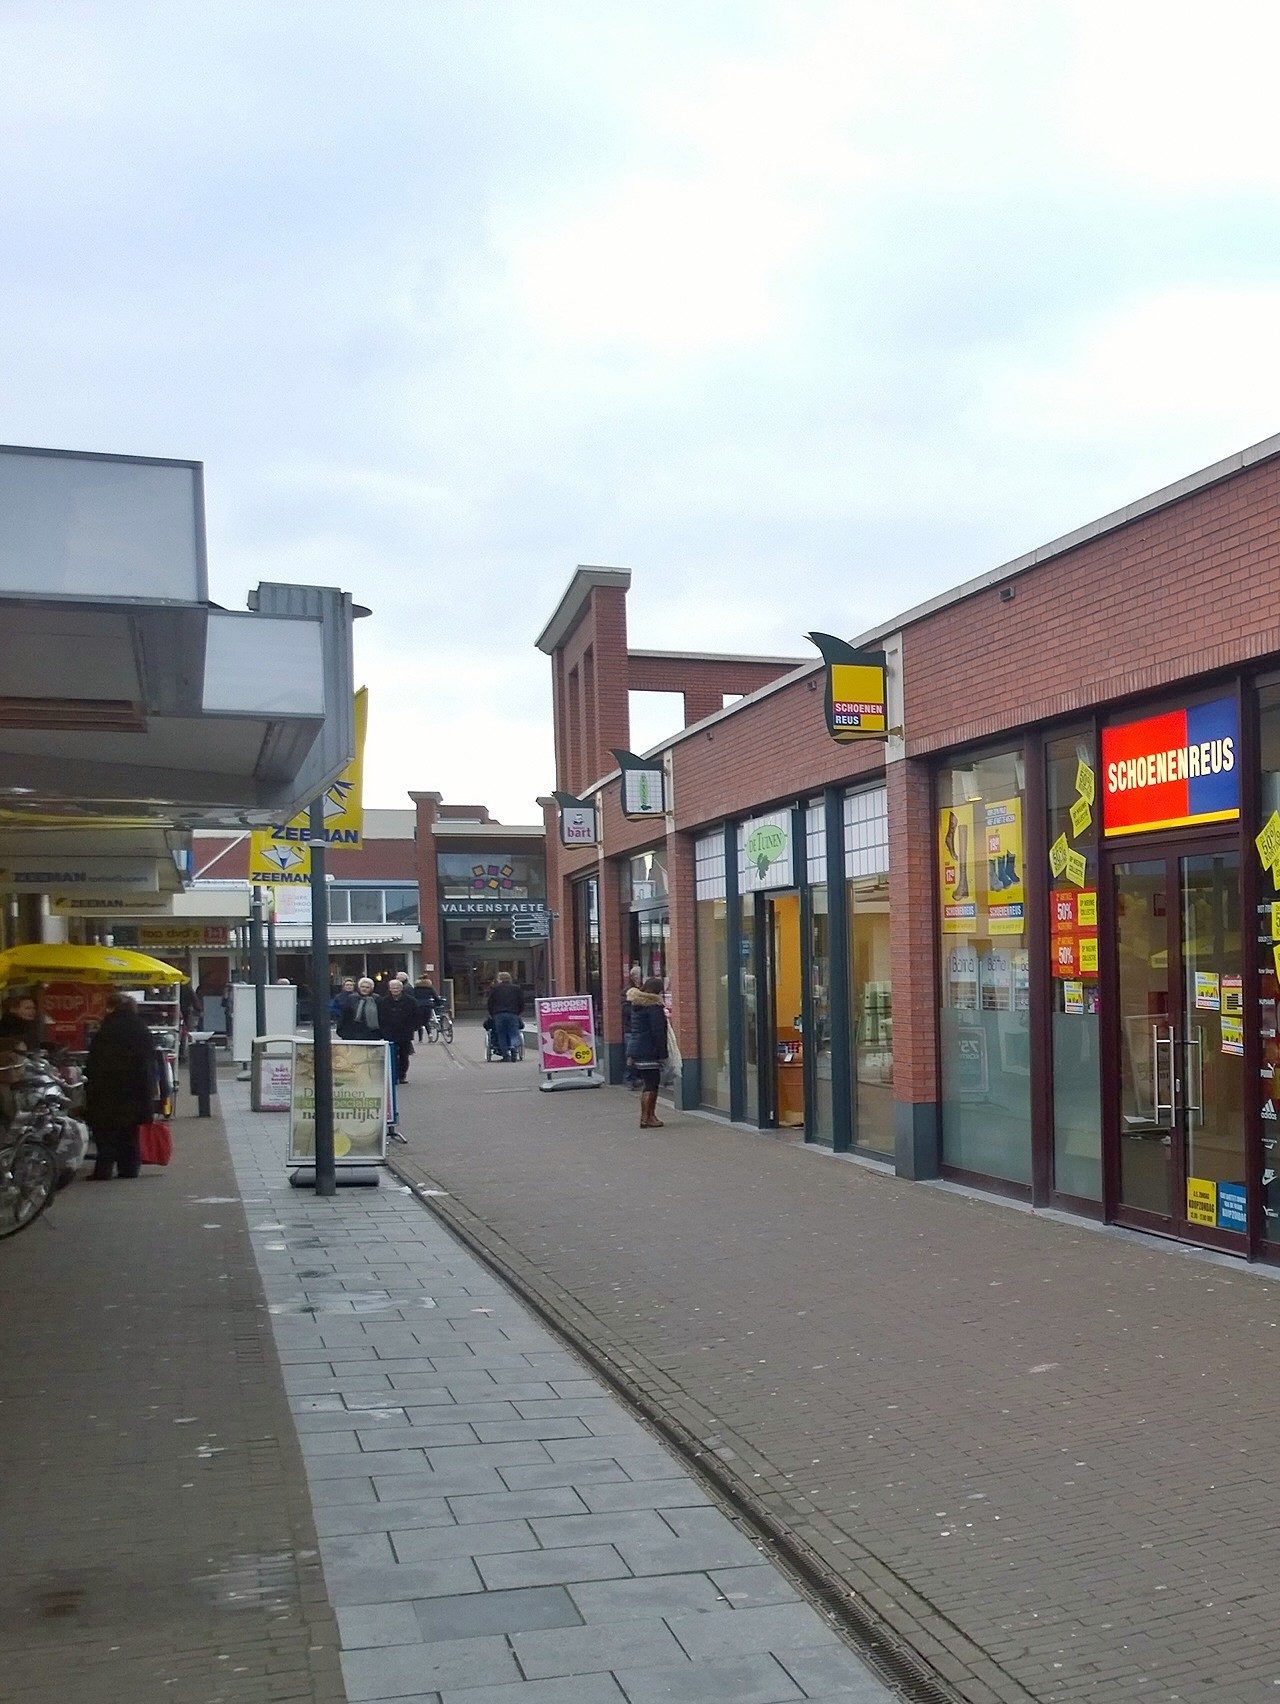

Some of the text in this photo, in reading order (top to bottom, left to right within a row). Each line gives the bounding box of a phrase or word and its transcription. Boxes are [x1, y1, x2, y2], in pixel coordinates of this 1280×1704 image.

[835, 702, 883, 714] SCHOENEN
[835, 715, 860, 726] REUS
[1108, 736, 1235, 794] SCHOENENREUS
[567, 827, 592, 838] bart
[252, 872, 311, 883] ZEEMAN
[442, 904, 544, 912] VALKENSTAETE
[1057, 903, 1073, 920] 50%
[1058, 946, 1073, 964] 50%
[541, 999, 588, 1013] 3 BRODEN
[333, 1088, 365, 1098] uinen
[1260, 1112, 1277, 1120] adidas
[1222, 1208, 1246, 1222] KOOPZONDA
